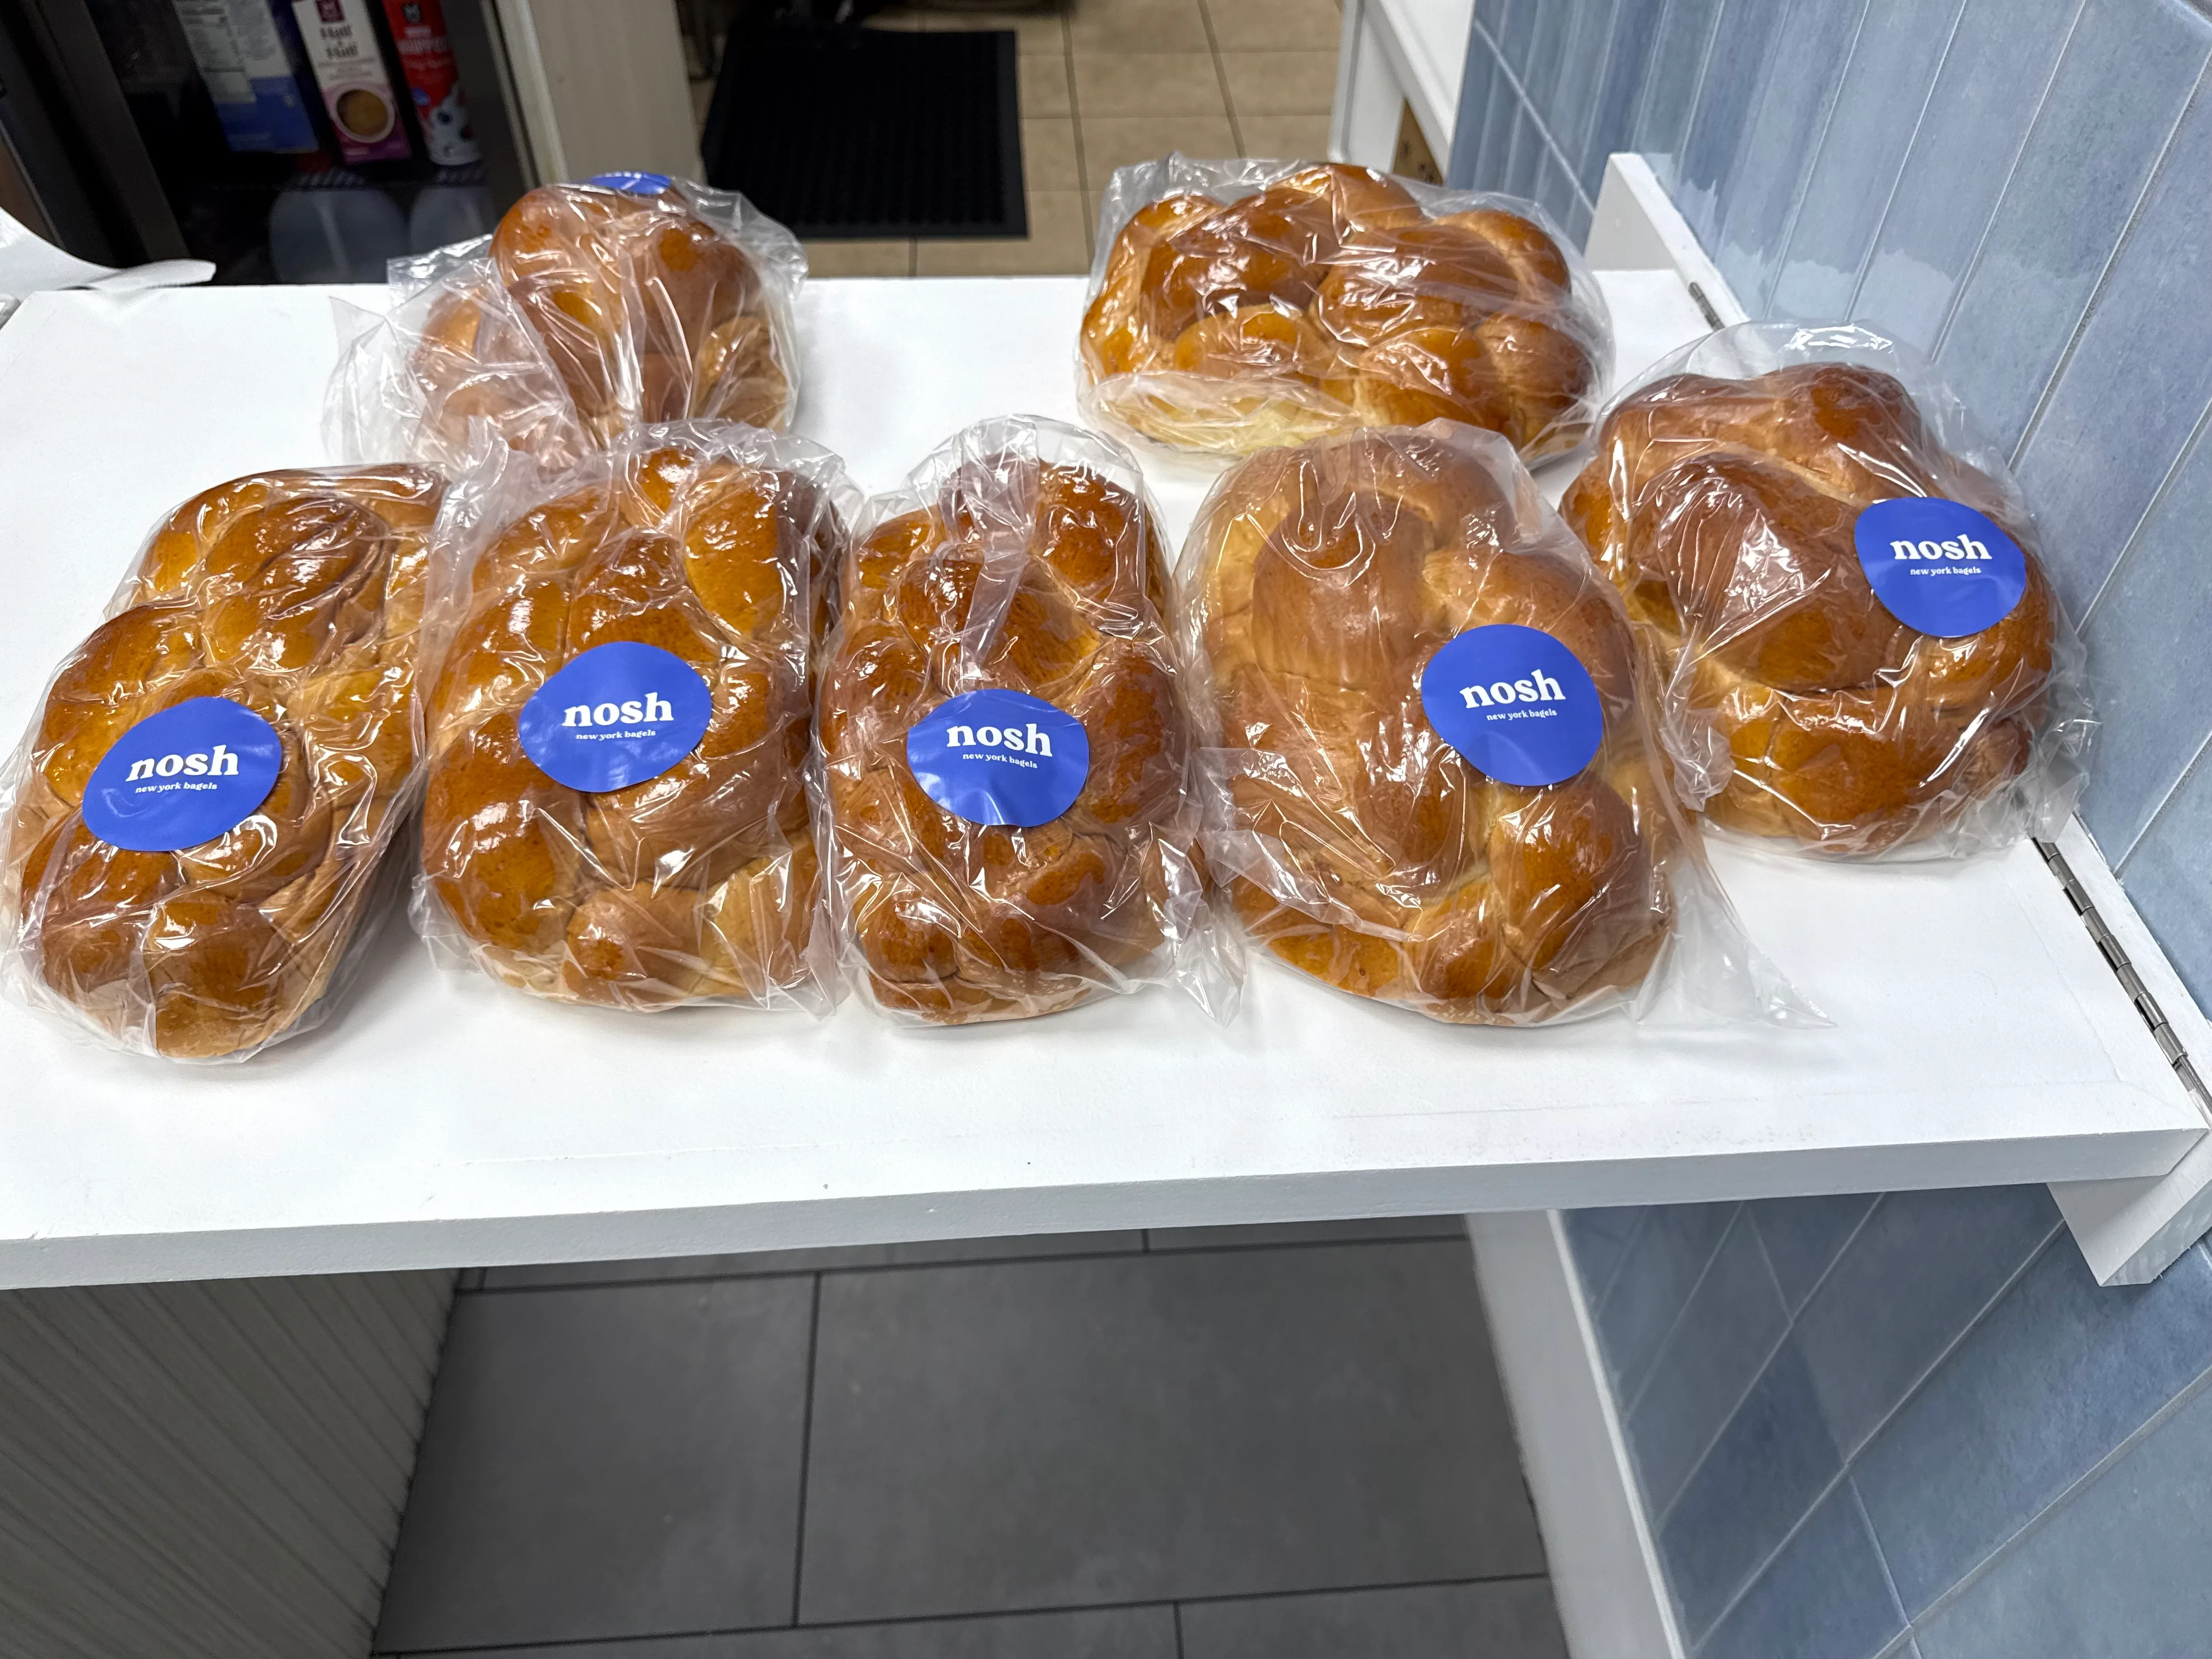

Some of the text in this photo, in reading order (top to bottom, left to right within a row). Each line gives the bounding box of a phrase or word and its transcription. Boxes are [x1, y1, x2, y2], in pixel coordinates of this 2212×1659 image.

[1890, 534, 1992, 560] nosh
[1931, 567, 1951, 577] york
[1952, 566, 1982, 576] bagels
[1459, 669, 1566, 708] nosh
[561, 692, 674, 726] nosh
[1508, 710, 1528, 721] york
[1528, 708, 1558, 718] bagels
[599, 731, 623, 741] york
[624, 729, 656, 738] bagels
[946, 723, 1053, 758] nosh
[125, 744, 239, 782] nosh
[1009, 755, 1038, 769] bagels
[135, 782, 218, 794] new york bagels
